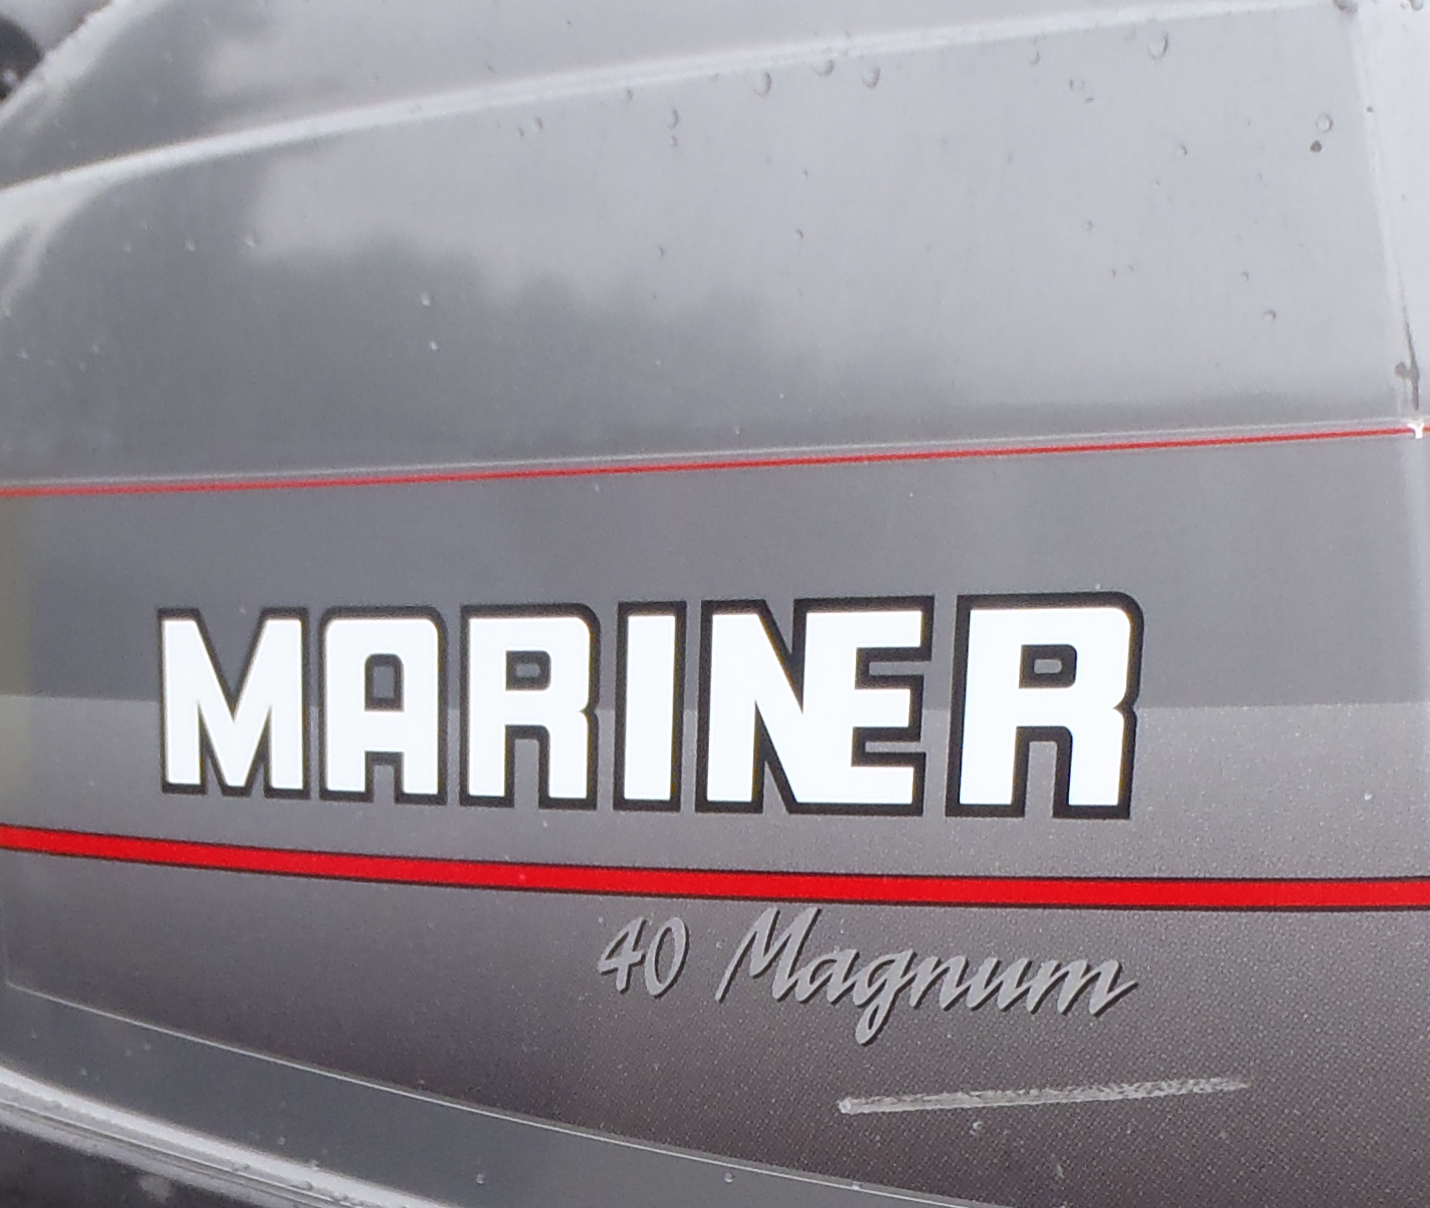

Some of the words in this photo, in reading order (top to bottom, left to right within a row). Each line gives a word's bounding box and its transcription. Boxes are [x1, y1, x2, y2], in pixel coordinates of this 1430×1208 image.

[157, 590, 1142, 819] MARINER
[597, 917, 690, 999] 40
[716, 907, 1139, 1046] Magnum
